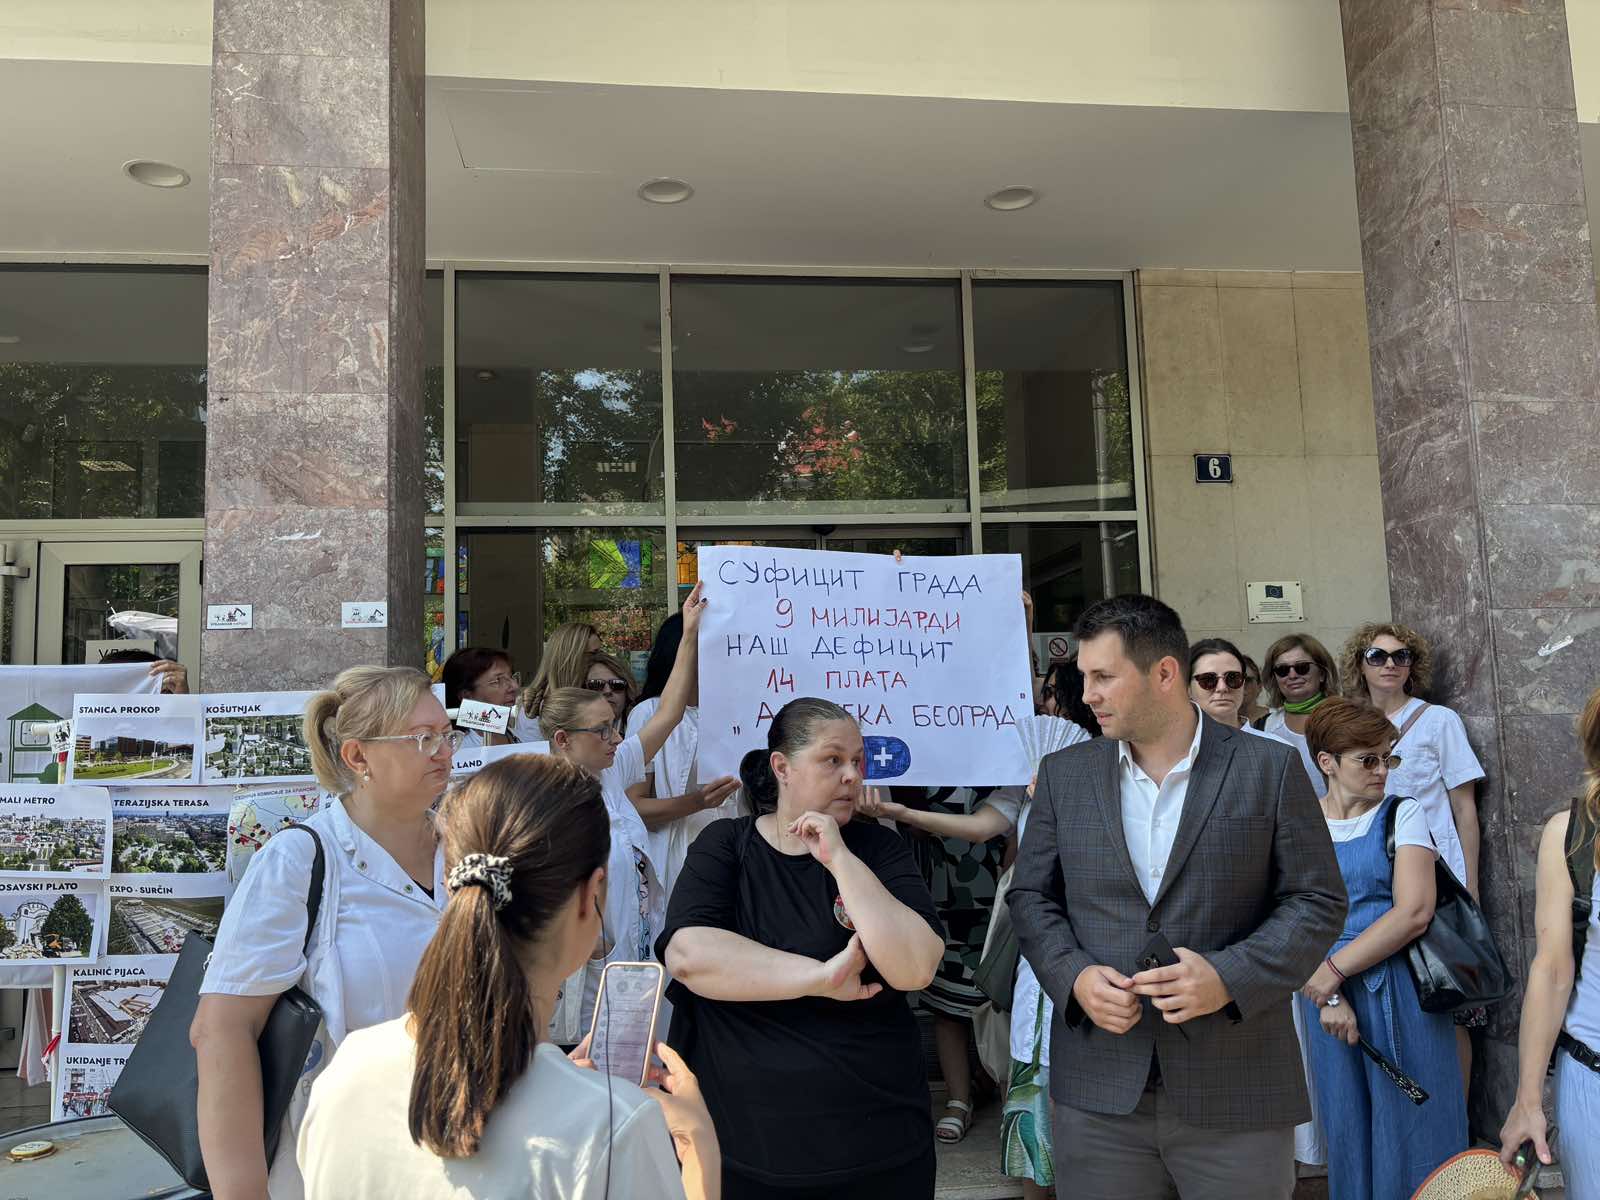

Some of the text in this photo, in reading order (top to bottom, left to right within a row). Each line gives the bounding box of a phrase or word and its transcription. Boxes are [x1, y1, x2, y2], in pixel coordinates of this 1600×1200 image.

[1208, 457, 1221, 478] 6
[898, 571, 983, 600] ГРАДА
[775, 598, 961, 634] 9 МИЛИЈАРДИ
[727, 633, 953, 667] НАШ ДЕФИЦИТ
[766, 667, 908, 693] 14 ПЛАТА
[79, 706, 161, 714] STANICA PROKOP
[206, 704, 262, 714] KOŠUTNJAK
[457, 760, 482, 769] LAND
[0, 796, 21, 804] MALI
[114, 799, 209, 808] TERAZIJSKA TERASA
[46, 882, 78, 890] PLATO
[109, 885, 133, 893] EXPO
[140, 884, 173, 894] SURČIN
[73, 966, 145, 978] KALINIĆ PIJACA
[66, 1056, 111, 1067] UKIDANJE
